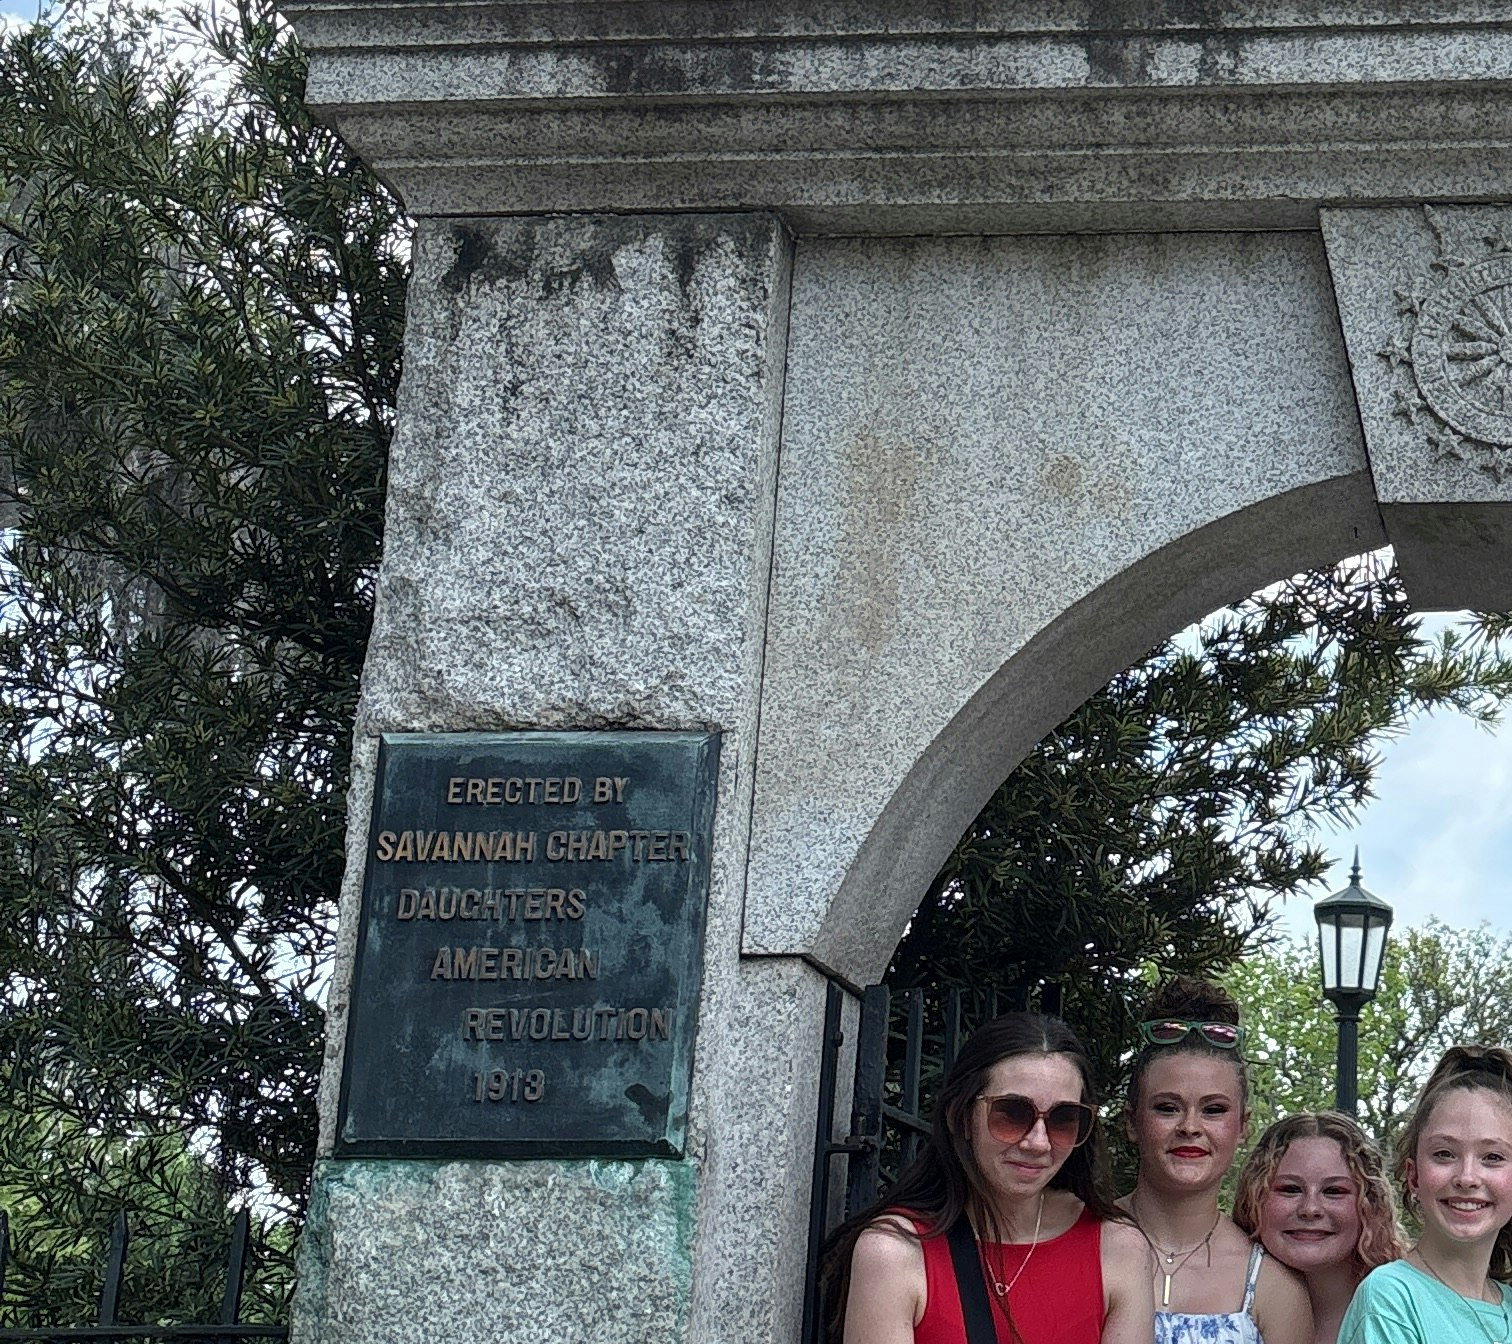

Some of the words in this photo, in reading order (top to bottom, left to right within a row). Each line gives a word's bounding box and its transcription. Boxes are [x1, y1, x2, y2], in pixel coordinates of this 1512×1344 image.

[447, 777, 583, 805] ERECTED
[594, 777, 630, 804] BY
[376, 831, 535, 862] SAVANNAH
[545, 831, 691, 861] CHAPTER
[397, 889, 587, 920] DAUGHTERS
[430, 948, 599, 981] AMERICAN
[462, 1008, 673, 1041] REVOLUTION
[473, 1069, 545, 1102] 1913
